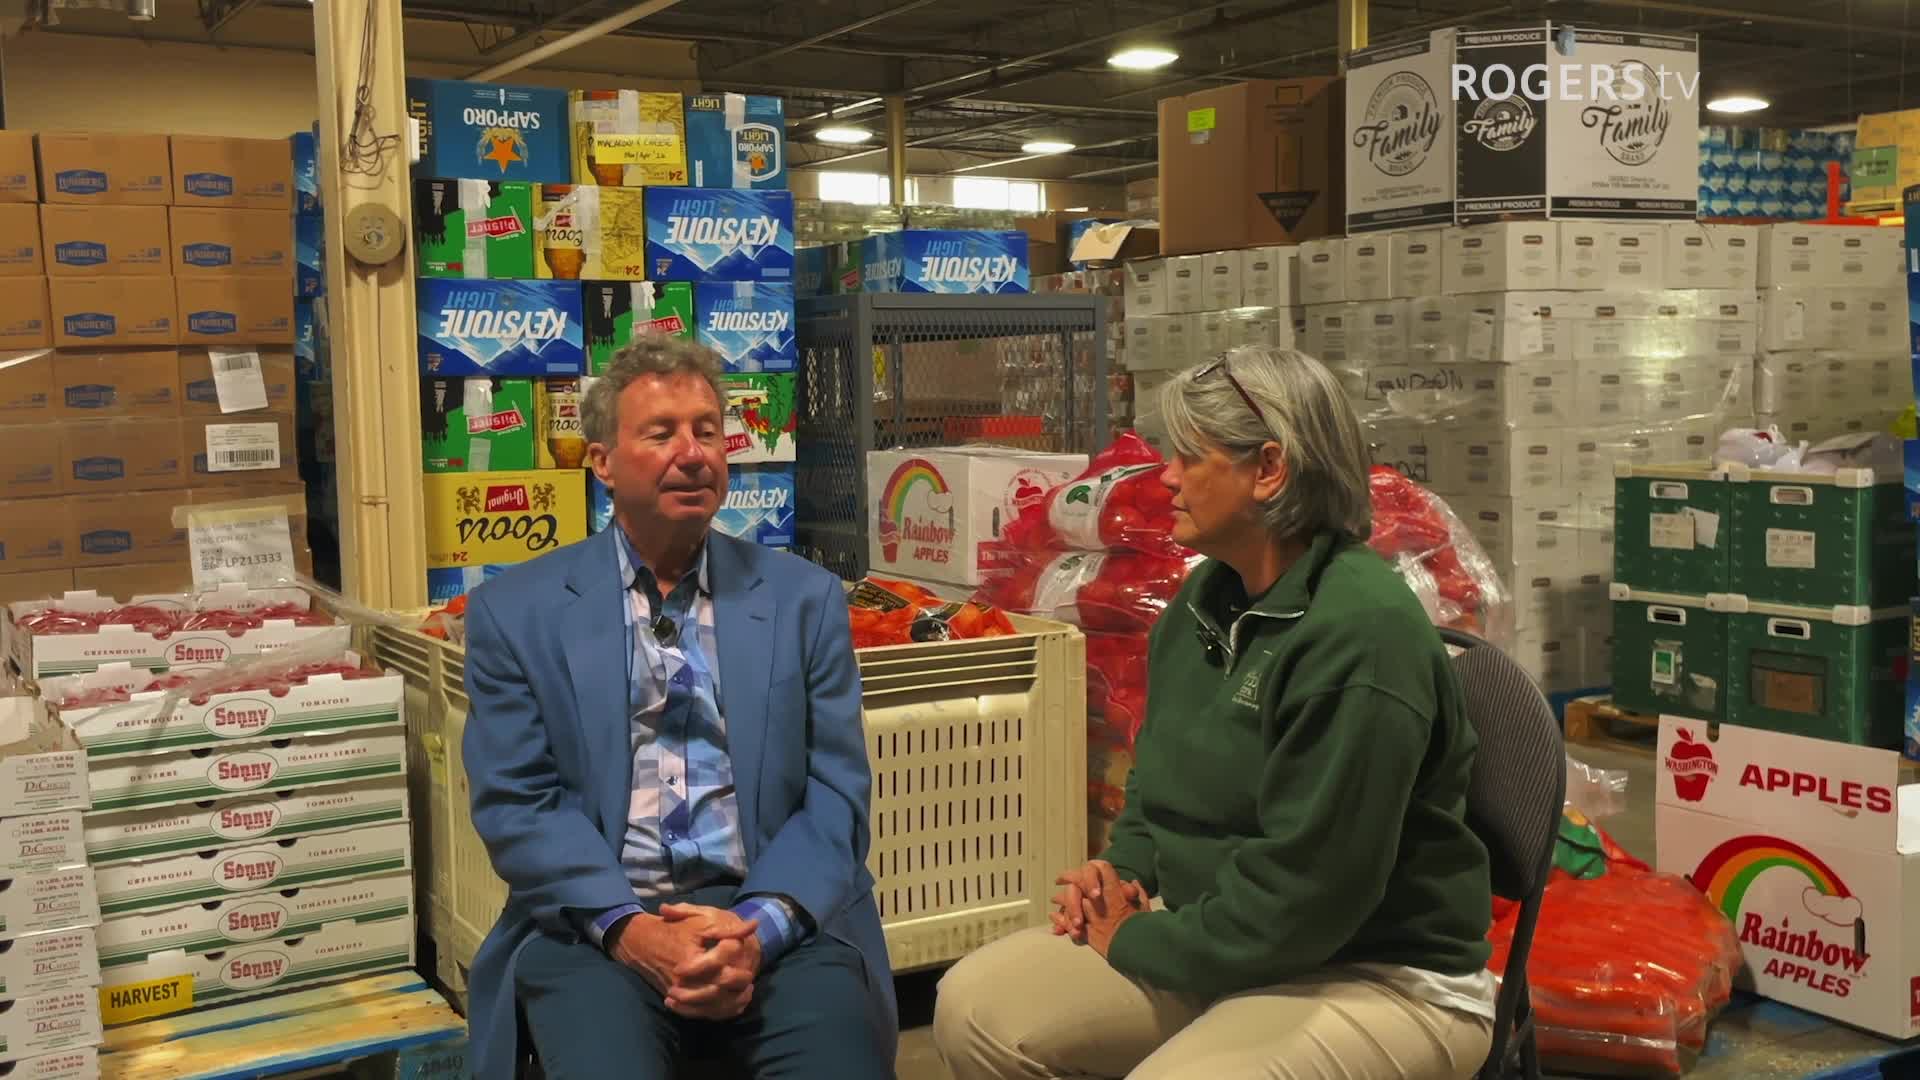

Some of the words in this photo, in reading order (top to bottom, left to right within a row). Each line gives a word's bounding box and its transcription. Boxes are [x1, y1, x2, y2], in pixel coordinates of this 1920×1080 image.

[692, 98, 720, 108] LIGHT
[463, 108, 540, 129] SAPPORO
[1464, 111, 1535, 141] Family
[1581, 97, 1669, 146] Family
[743, 131, 769, 141] LIGHT
[1353, 101, 1440, 162] Family
[738, 143, 774, 152] SAPPORO
[669, 199, 715, 217] LIGHT
[1465, 202, 1501, 210] PREMIUM
[1503, 200, 1541, 208] PRODUCE
[469, 218, 518, 234] Pilsner
[664, 215, 779, 246] KEYSTONE
[925, 240, 962, 256] LIGHT
[919, 255, 1018, 282] KEYSTONE
[443, 291, 497, 309] LIGHT
[436, 308, 568, 340] KEYSTONE
[706, 310, 790, 331] KEYSTONE
[470, 412, 518, 429] Pilsner
[488, 487, 525, 511] Original
[455, 514, 560, 551] Coors
[902, 515, 955, 544] Rainbow
[225, 551, 283, 568] LP213333
[452, 551, 468, 562] 24
[913, 546, 950, 564] APPLES
[83, 648, 147, 657] GREENHOUSE
[175, 644, 224, 661] Sonny
[116, 714, 184, 728] GREENHOUSE
[214, 708, 268, 726] Sonny
[301, 697, 350, 708] TOMATOES
[218, 761, 272, 780] Sonny
[1664, 757, 1718, 774] WASHINGTON
[1739, 763, 1892, 814] APPLES
[124, 818, 191, 833] GREENHOUSE
[221, 809, 274, 829] Sonny
[306, 796, 355, 808] TOMATOES
[127, 870, 193, 886] GREENHOUSE
[223, 861, 276, 880] Sonny
[308, 846, 357, 858] TOMATOES
[228, 911, 281, 931] Sonny
[296, 899, 338, 911] TOMATES
[1739, 911, 1871, 974] Rainbow
[230, 959, 283, 979] Sonny
[314, 941, 363, 954] TOMATOES
[1763, 957, 1852, 998] APPLES
[110, 981, 180, 1009] HARVEST
